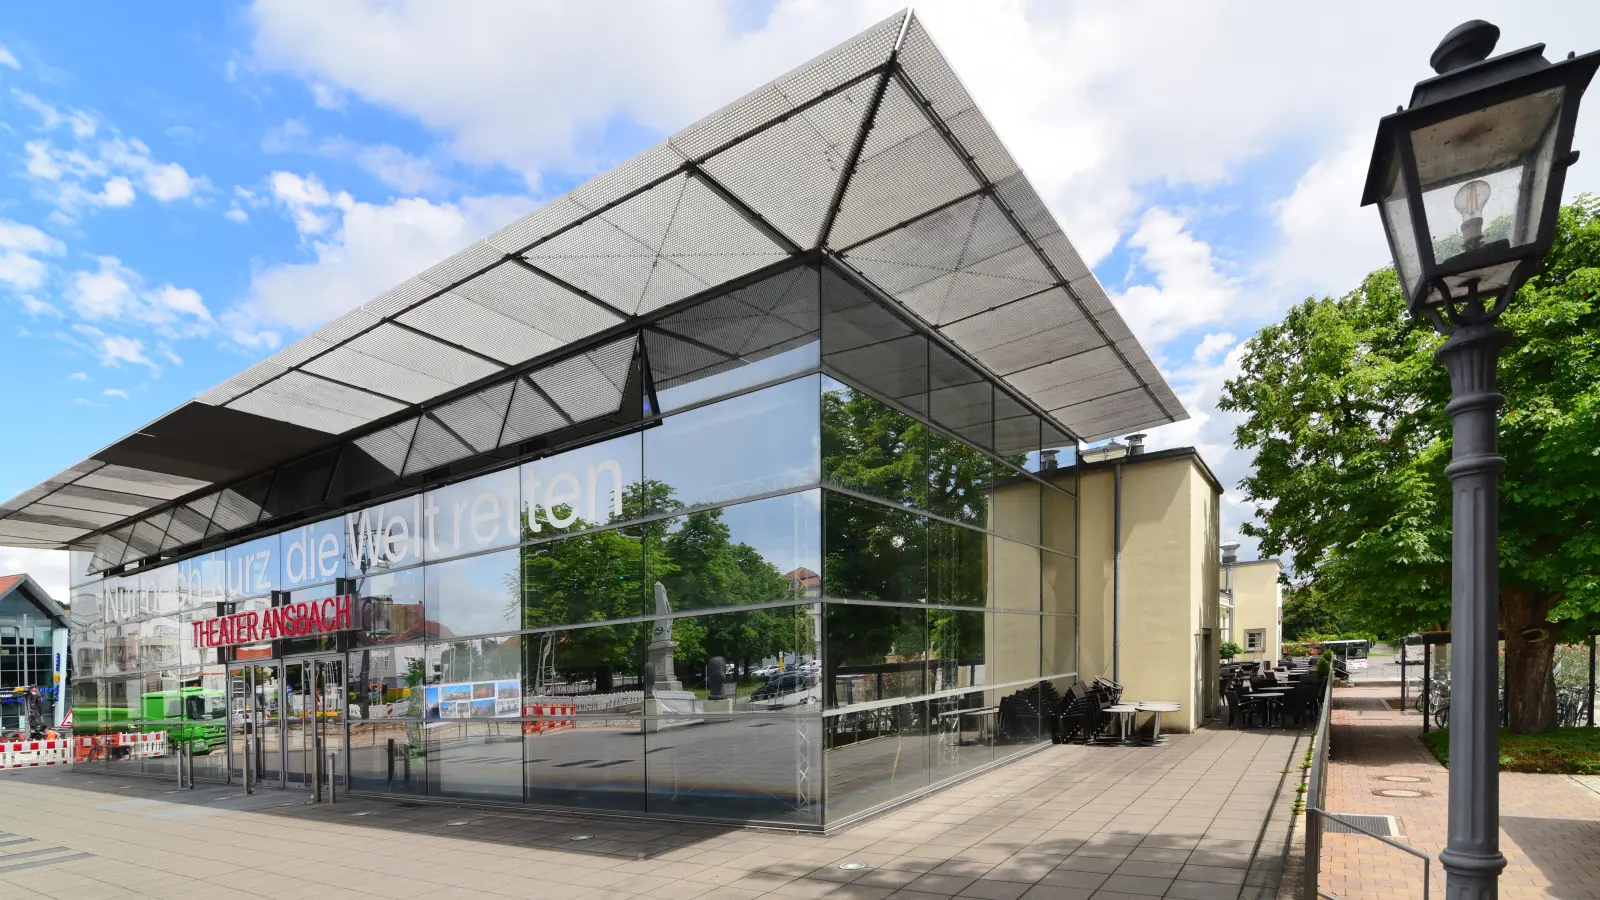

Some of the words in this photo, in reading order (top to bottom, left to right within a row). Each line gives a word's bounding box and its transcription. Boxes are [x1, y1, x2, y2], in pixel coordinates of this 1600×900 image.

[104, 582, 137, 624] Nur
[144, 559, 202, 613] nch
[211, 550, 272, 602] kurz
[286, 523, 340, 583] die
[348, 492, 440, 570] Welt
[453, 457, 623, 549] retten
[192, 611, 259, 648] THEATER
[262, 594, 351, 639] ANSBACH
